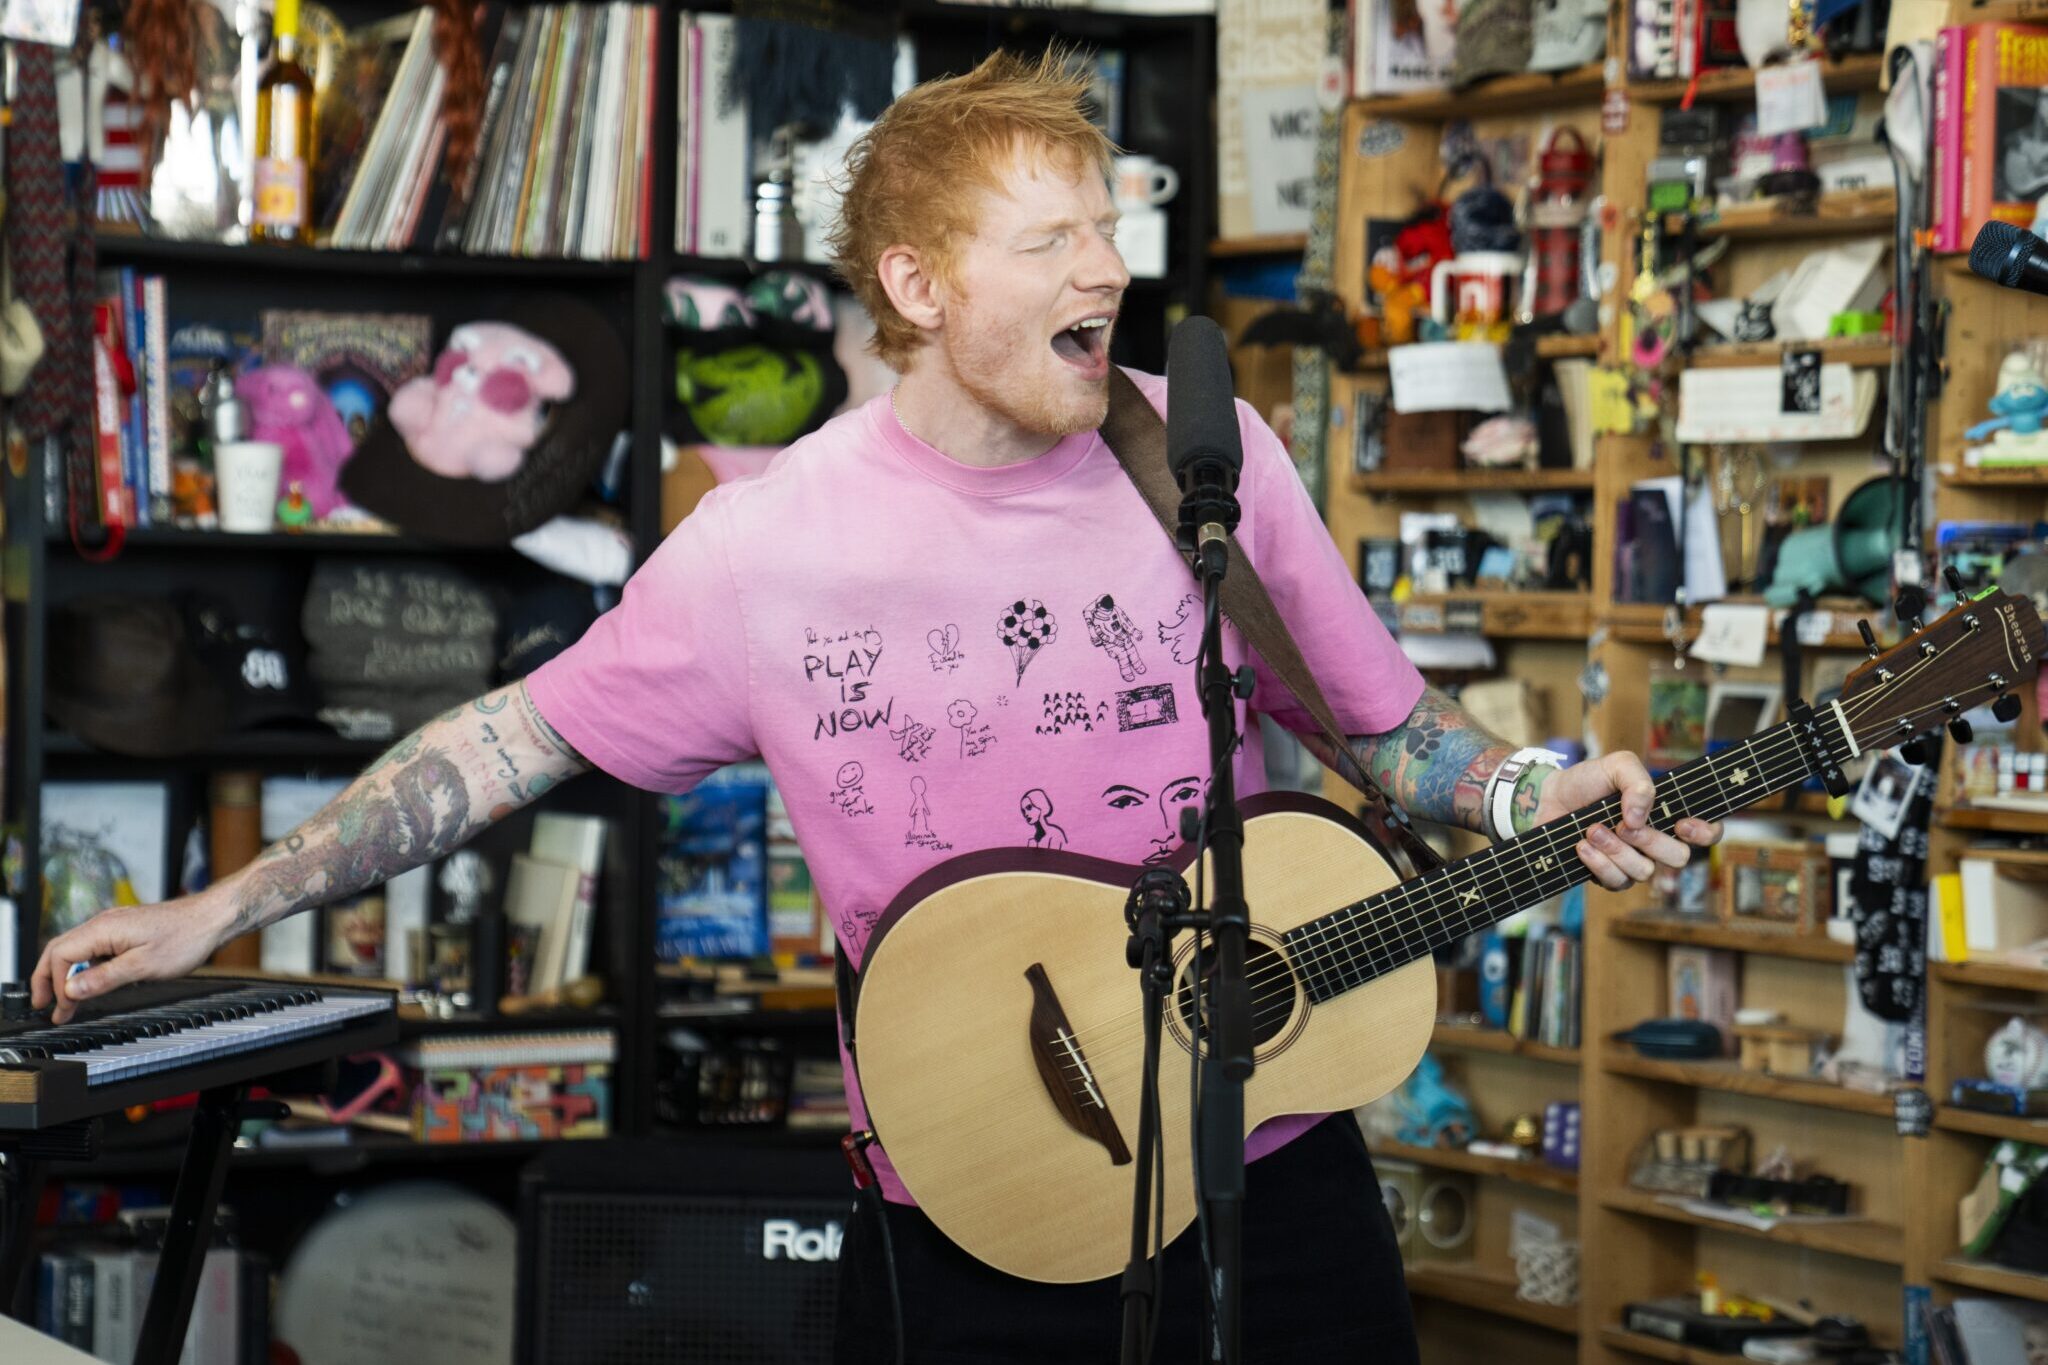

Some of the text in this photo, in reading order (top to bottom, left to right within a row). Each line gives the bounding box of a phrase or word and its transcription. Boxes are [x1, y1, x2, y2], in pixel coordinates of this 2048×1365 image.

[2003, 604, 2032, 663] Sheeran
[803, 646, 883, 681] PLAY
[814, 696, 893, 740] NOW
